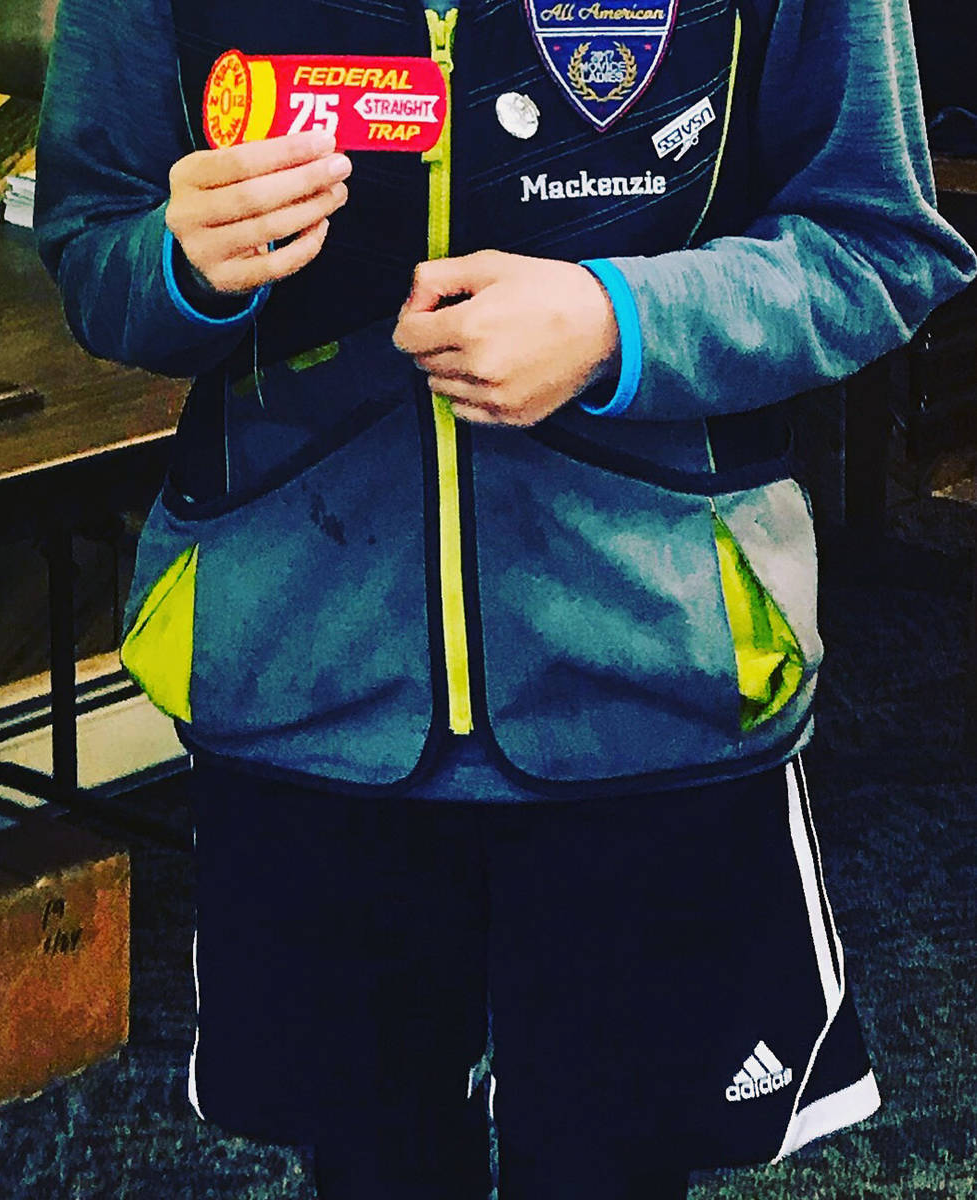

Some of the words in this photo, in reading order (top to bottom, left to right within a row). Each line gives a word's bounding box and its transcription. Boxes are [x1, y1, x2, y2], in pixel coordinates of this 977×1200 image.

[540, 3, 575, 22] All
[578, 2, 665, 21] American
[579, 61, 627, 74] NOVICE
[581, 71, 624, 83] LADIES
[292, 66, 413, 90] FEDERAL
[286, 92, 340, 139] 75
[363, 98, 433, 117] STRAIGHT
[367, 122, 421, 141] TRAP
[520, 170, 667, 203] Mackenzie
[725, 1067, 793, 1102] adidas
